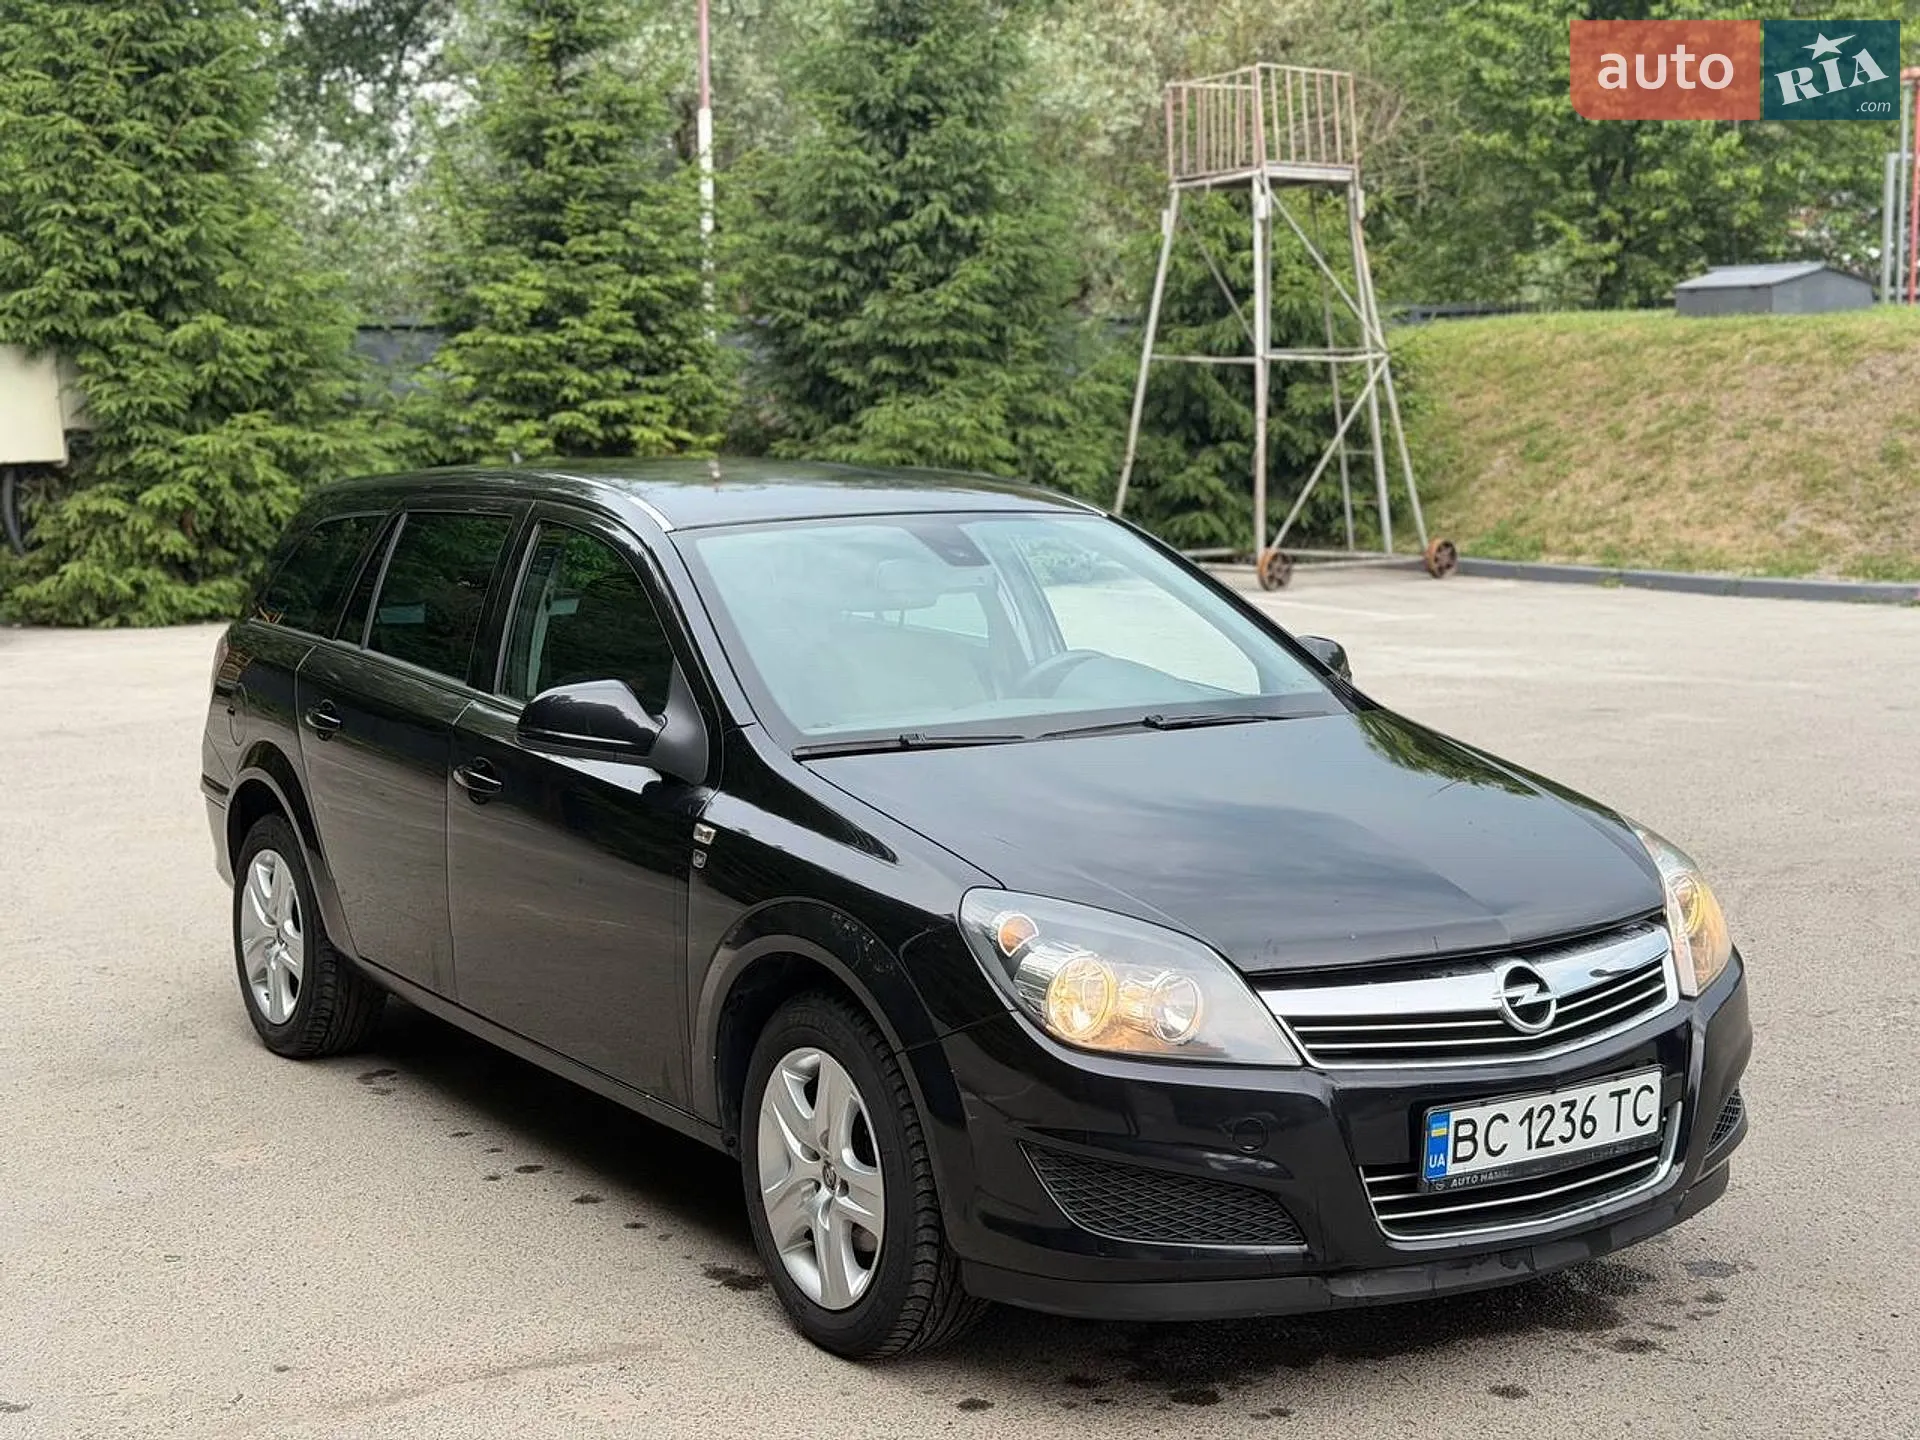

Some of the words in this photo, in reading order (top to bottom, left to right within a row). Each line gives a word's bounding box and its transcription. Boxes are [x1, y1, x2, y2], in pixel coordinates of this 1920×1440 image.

[1452, 1113, 1510, 1163] BC
[1519, 1095, 1597, 1150] 1236
[1609, 1085, 1655, 1133] TC
[1428, 1154, 1446, 1169] UA
[1450, 1175, 1479, 1188] AUTO
